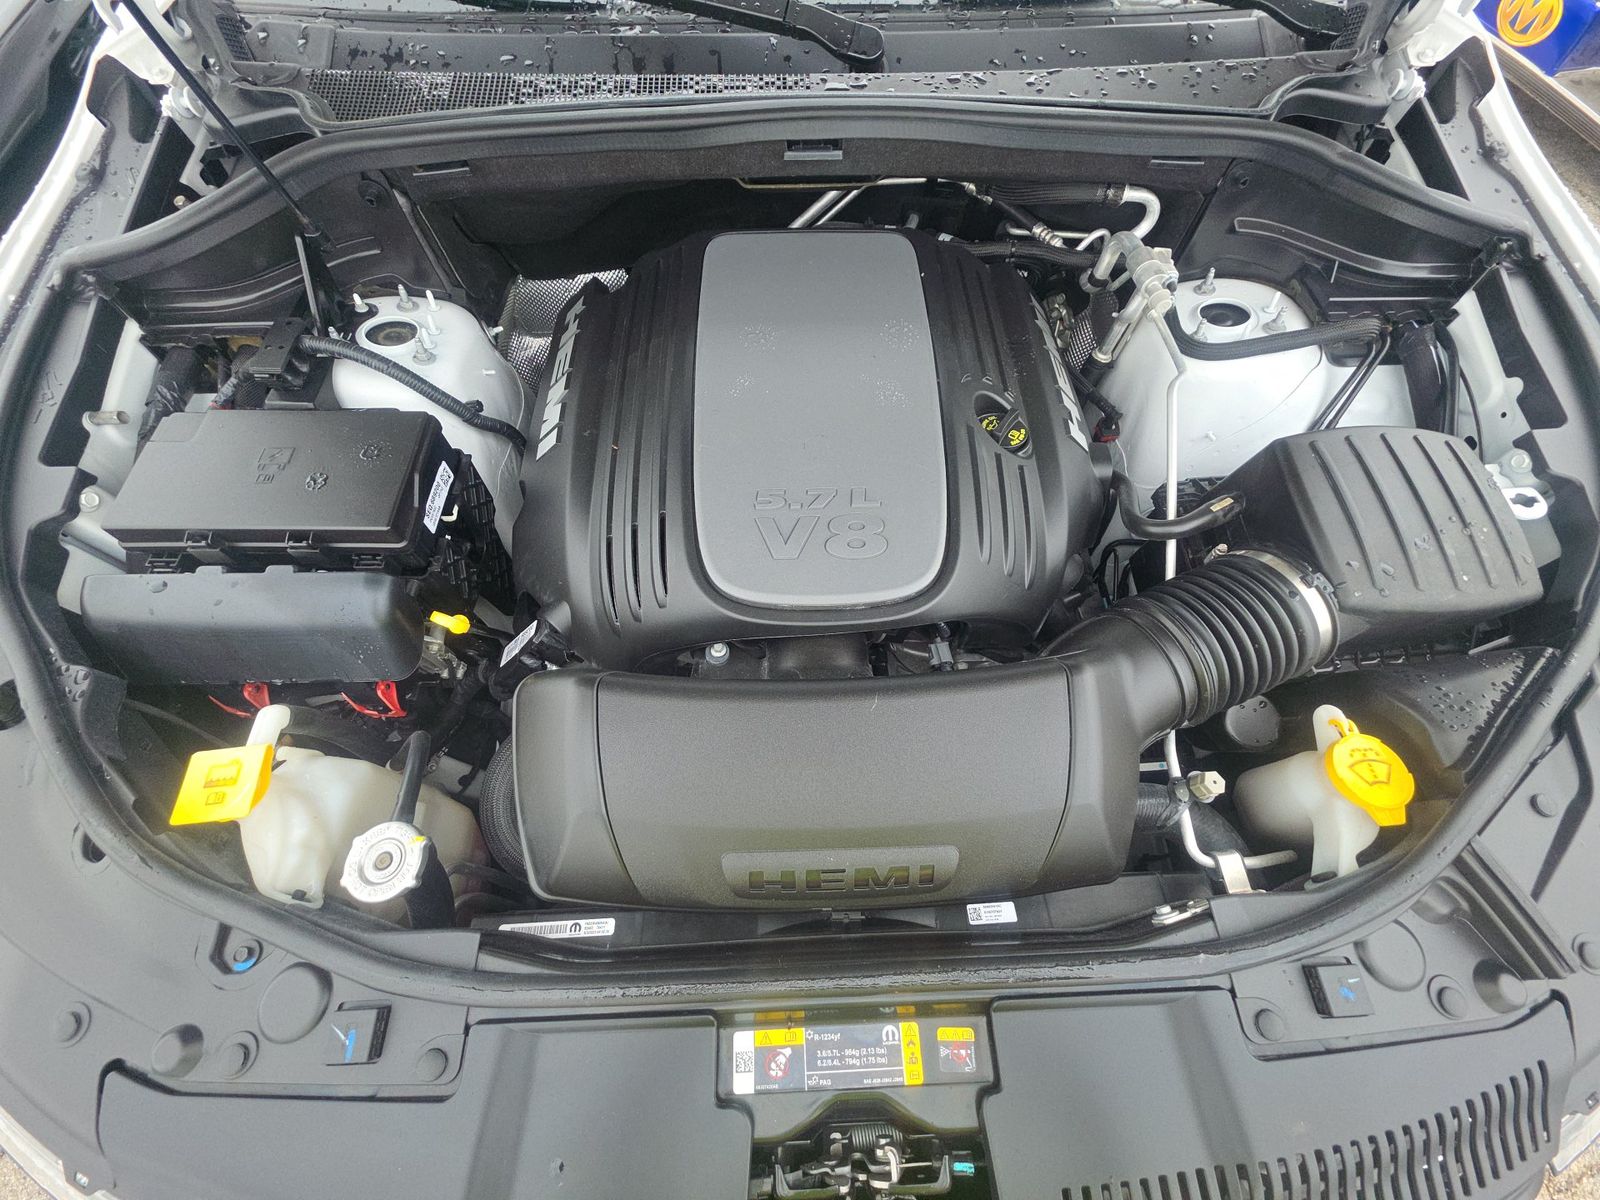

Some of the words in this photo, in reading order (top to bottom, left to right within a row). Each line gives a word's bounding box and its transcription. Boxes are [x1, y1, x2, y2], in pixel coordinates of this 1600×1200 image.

[536, 296, 587, 461] HEMI
[753, 511, 889, 560] V8
[748, 864, 936, 894] HEMI
[814, 1033, 841, 1041] R-1234yf
